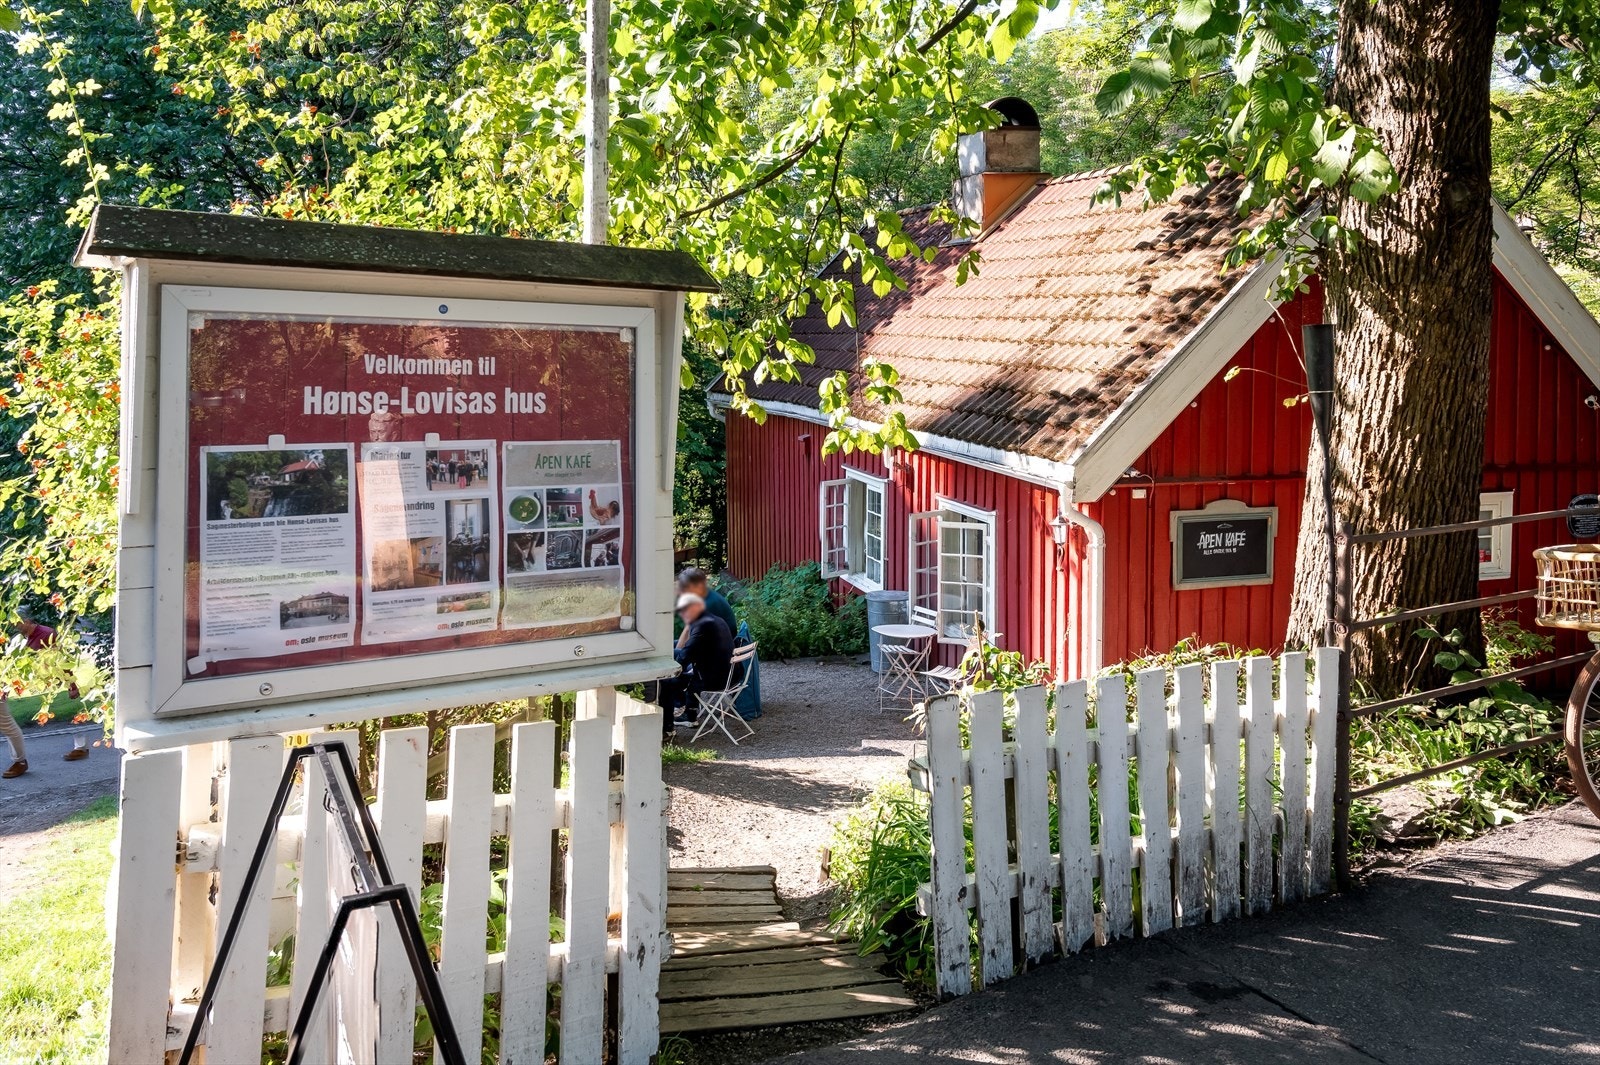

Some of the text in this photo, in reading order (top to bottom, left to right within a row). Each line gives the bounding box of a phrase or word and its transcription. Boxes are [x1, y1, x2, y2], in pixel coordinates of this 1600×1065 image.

[364, 354, 496, 376] Velkommen til
[303, 385, 547, 415] Hønse-Lovisas hus
[400, 450, 412, 460] tur
[534, 452, 592, 470] ÅPEN KAFÉ
[206, 520, 261, 530] Sagmesterboligen
[276, 519, 286, 527] ble
[1197, 530, 1247, 549] ÅPEN KAFÉ
[450, 620, 465, 629] oslo
[300, 635, 316, 645] oslo
[317, 631, 348, 642] museum
